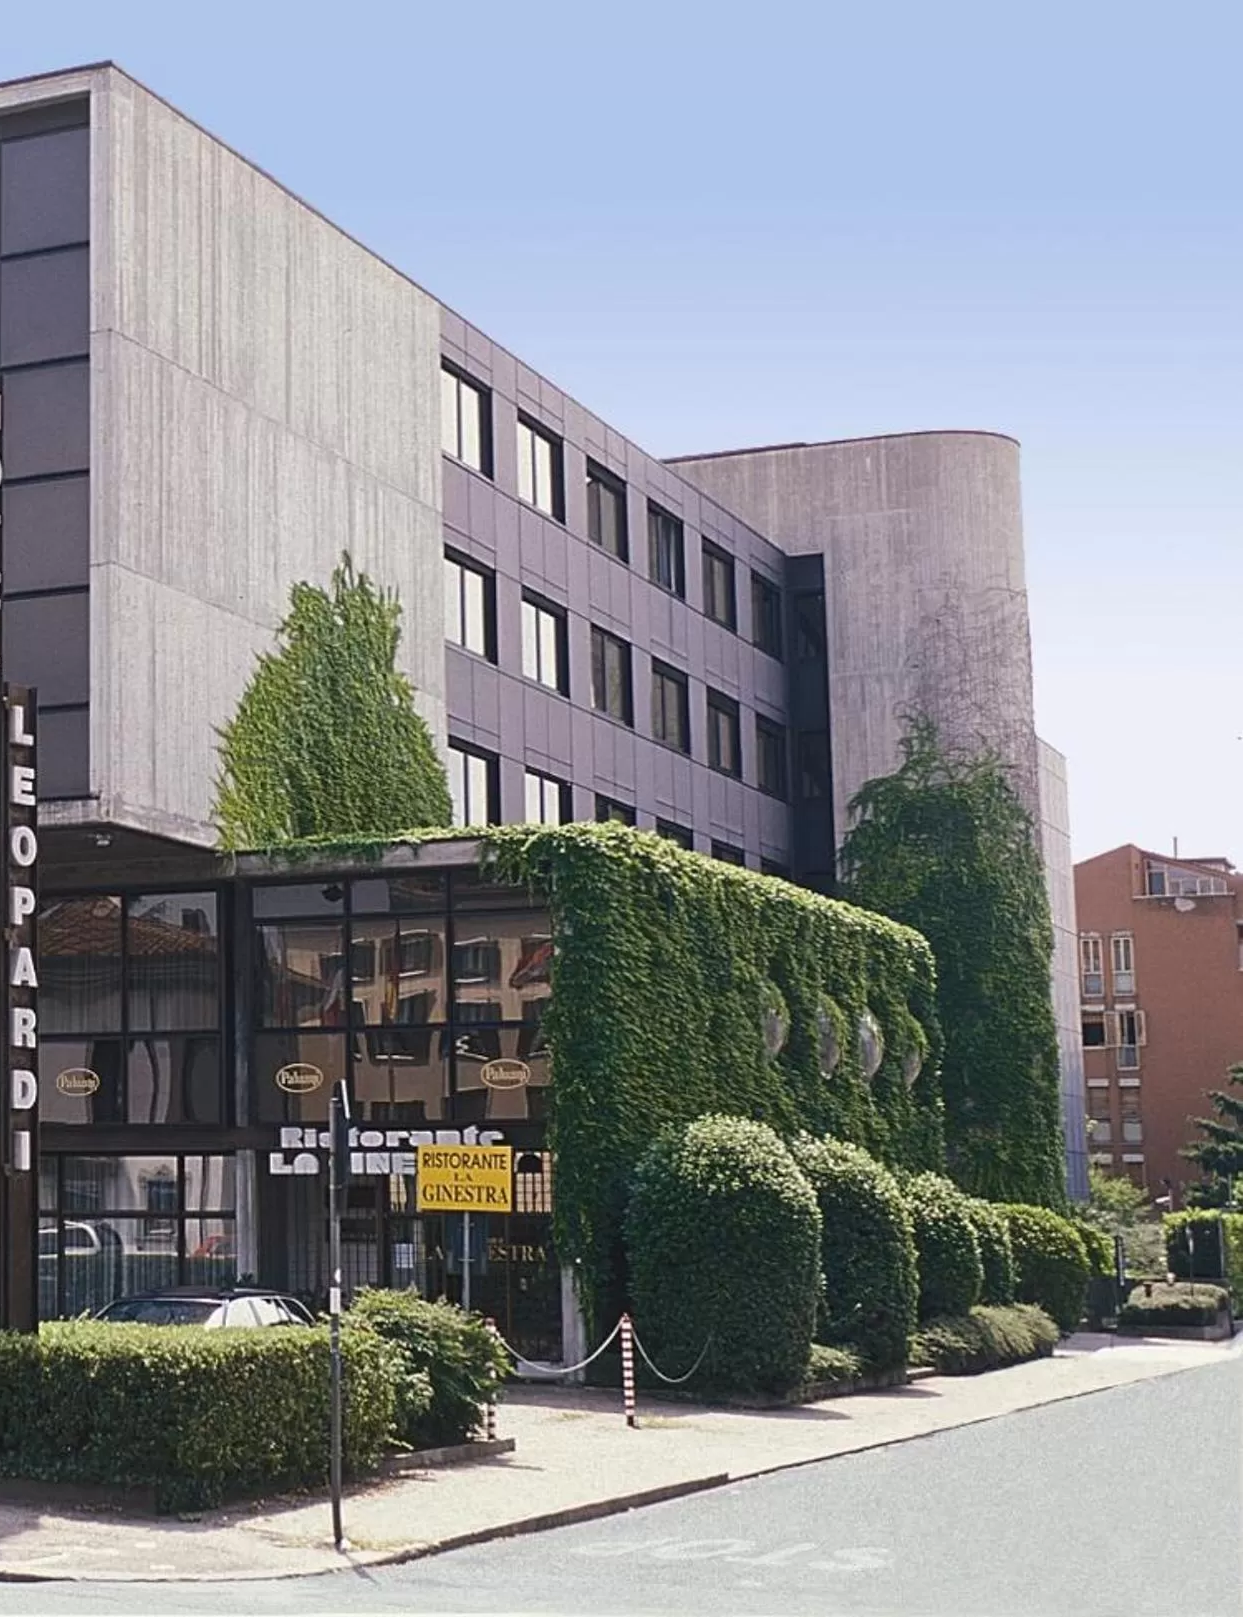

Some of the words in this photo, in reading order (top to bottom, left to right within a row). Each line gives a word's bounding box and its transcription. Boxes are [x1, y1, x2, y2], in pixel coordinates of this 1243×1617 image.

[8, 704, 38, 1172] LEOPARDI
[422, 1152, 508, 1170] RISTORANTE
[454, 1172, 474, 1182] LA
[422, 1183, 509, 1204] GINESTRA
